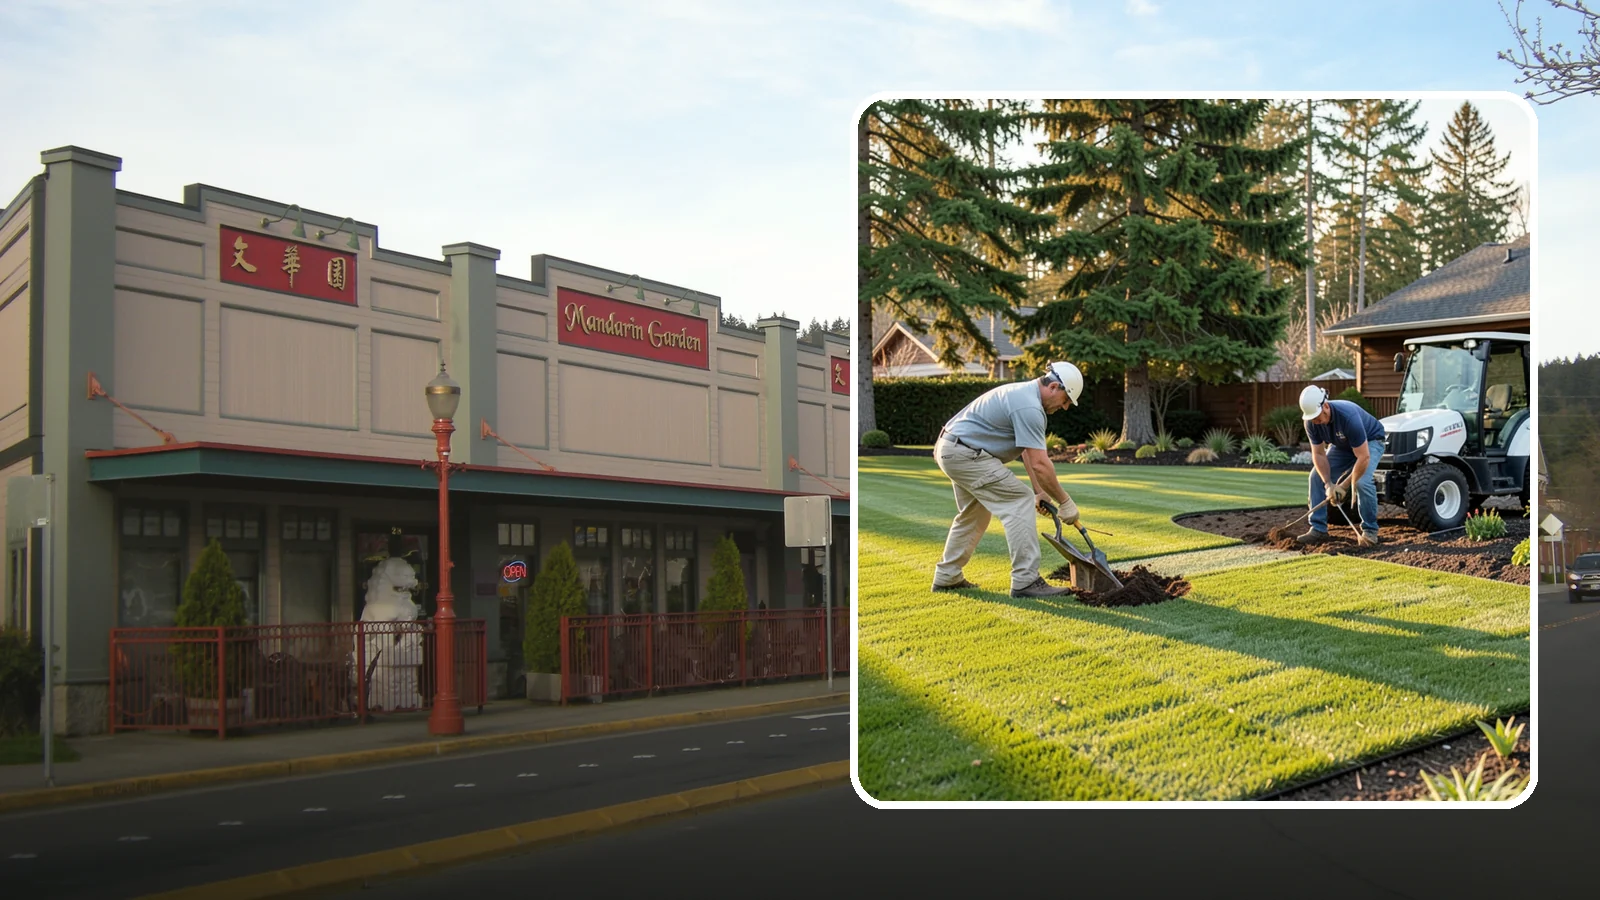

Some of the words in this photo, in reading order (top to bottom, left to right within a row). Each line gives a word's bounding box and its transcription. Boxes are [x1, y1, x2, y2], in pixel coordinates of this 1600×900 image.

[564, 302, 644, 341] Mandarin
[647, 320, 701, 352] Garden
[503, 565, 527, 578] OPEN
